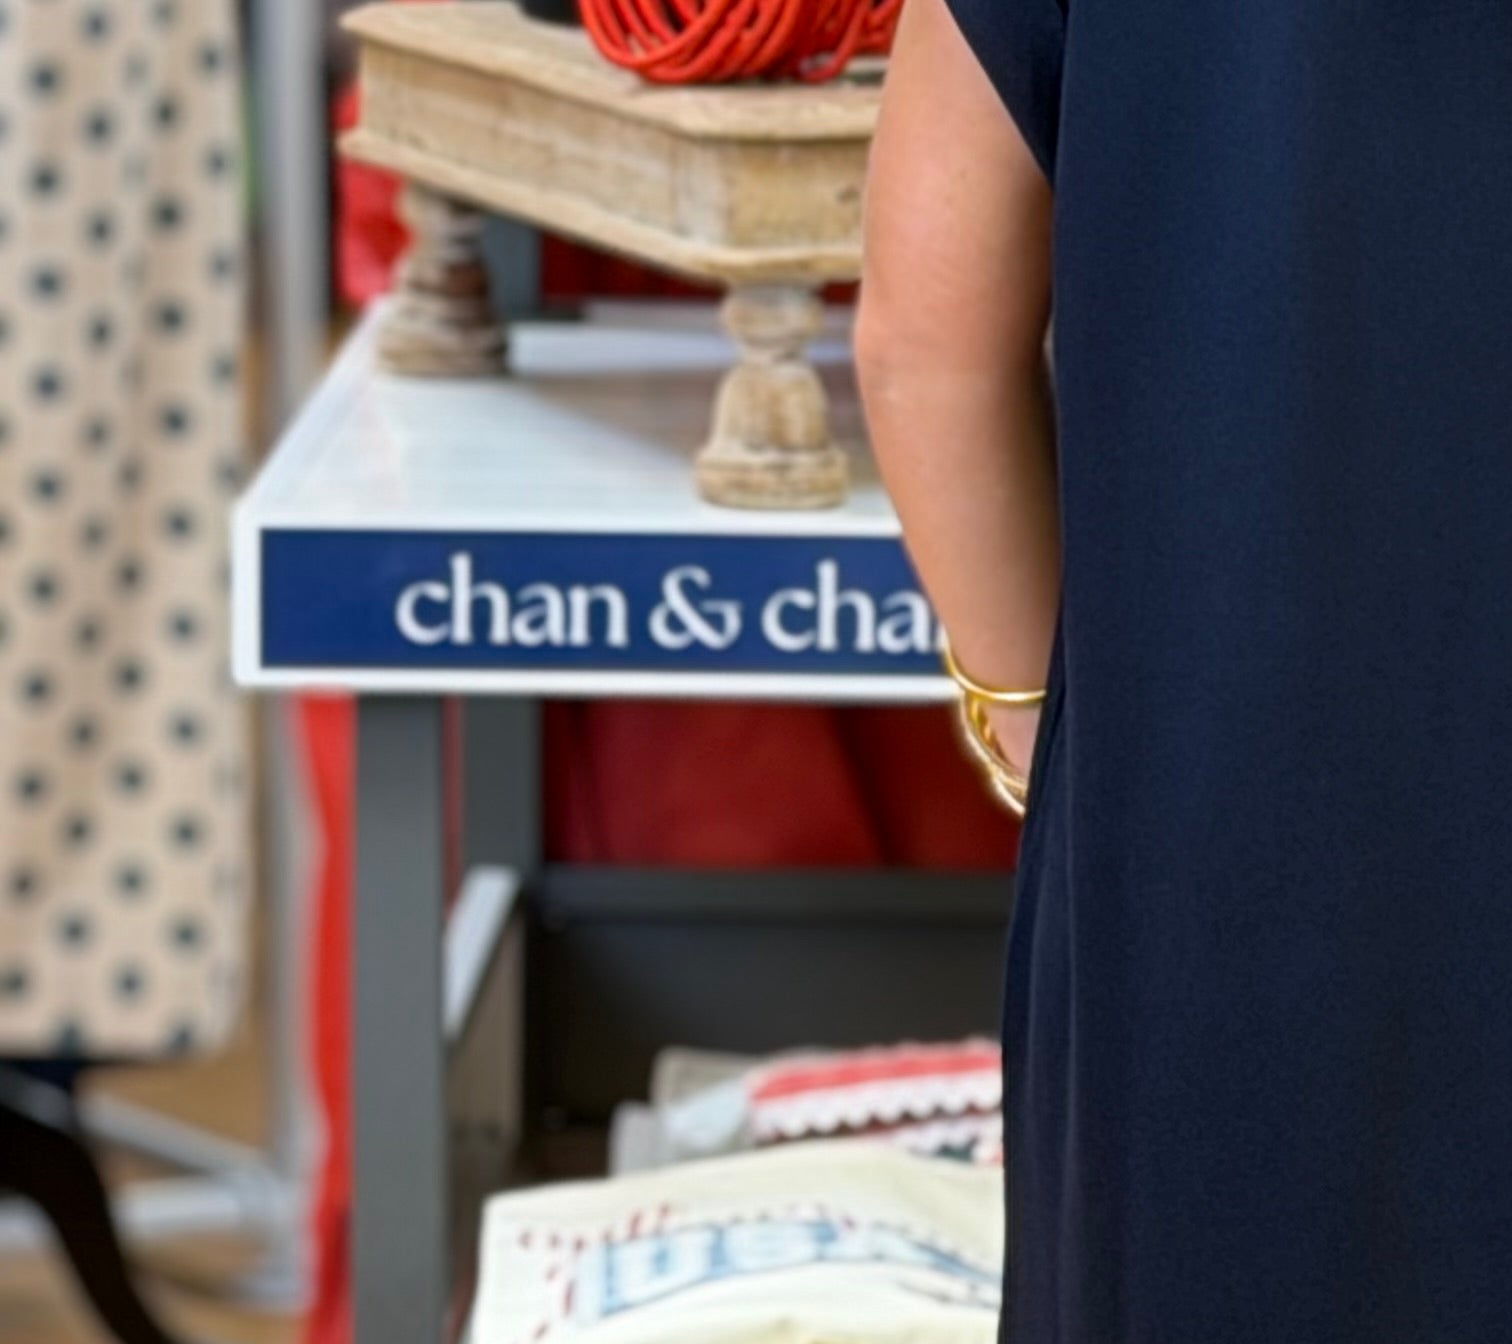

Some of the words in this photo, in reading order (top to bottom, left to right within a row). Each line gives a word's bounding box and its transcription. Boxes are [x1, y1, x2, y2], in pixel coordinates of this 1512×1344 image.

[395, 552, 629, 647] chan
[648, 565, 744, 649] &
[761, 559, 950, 654] cha
